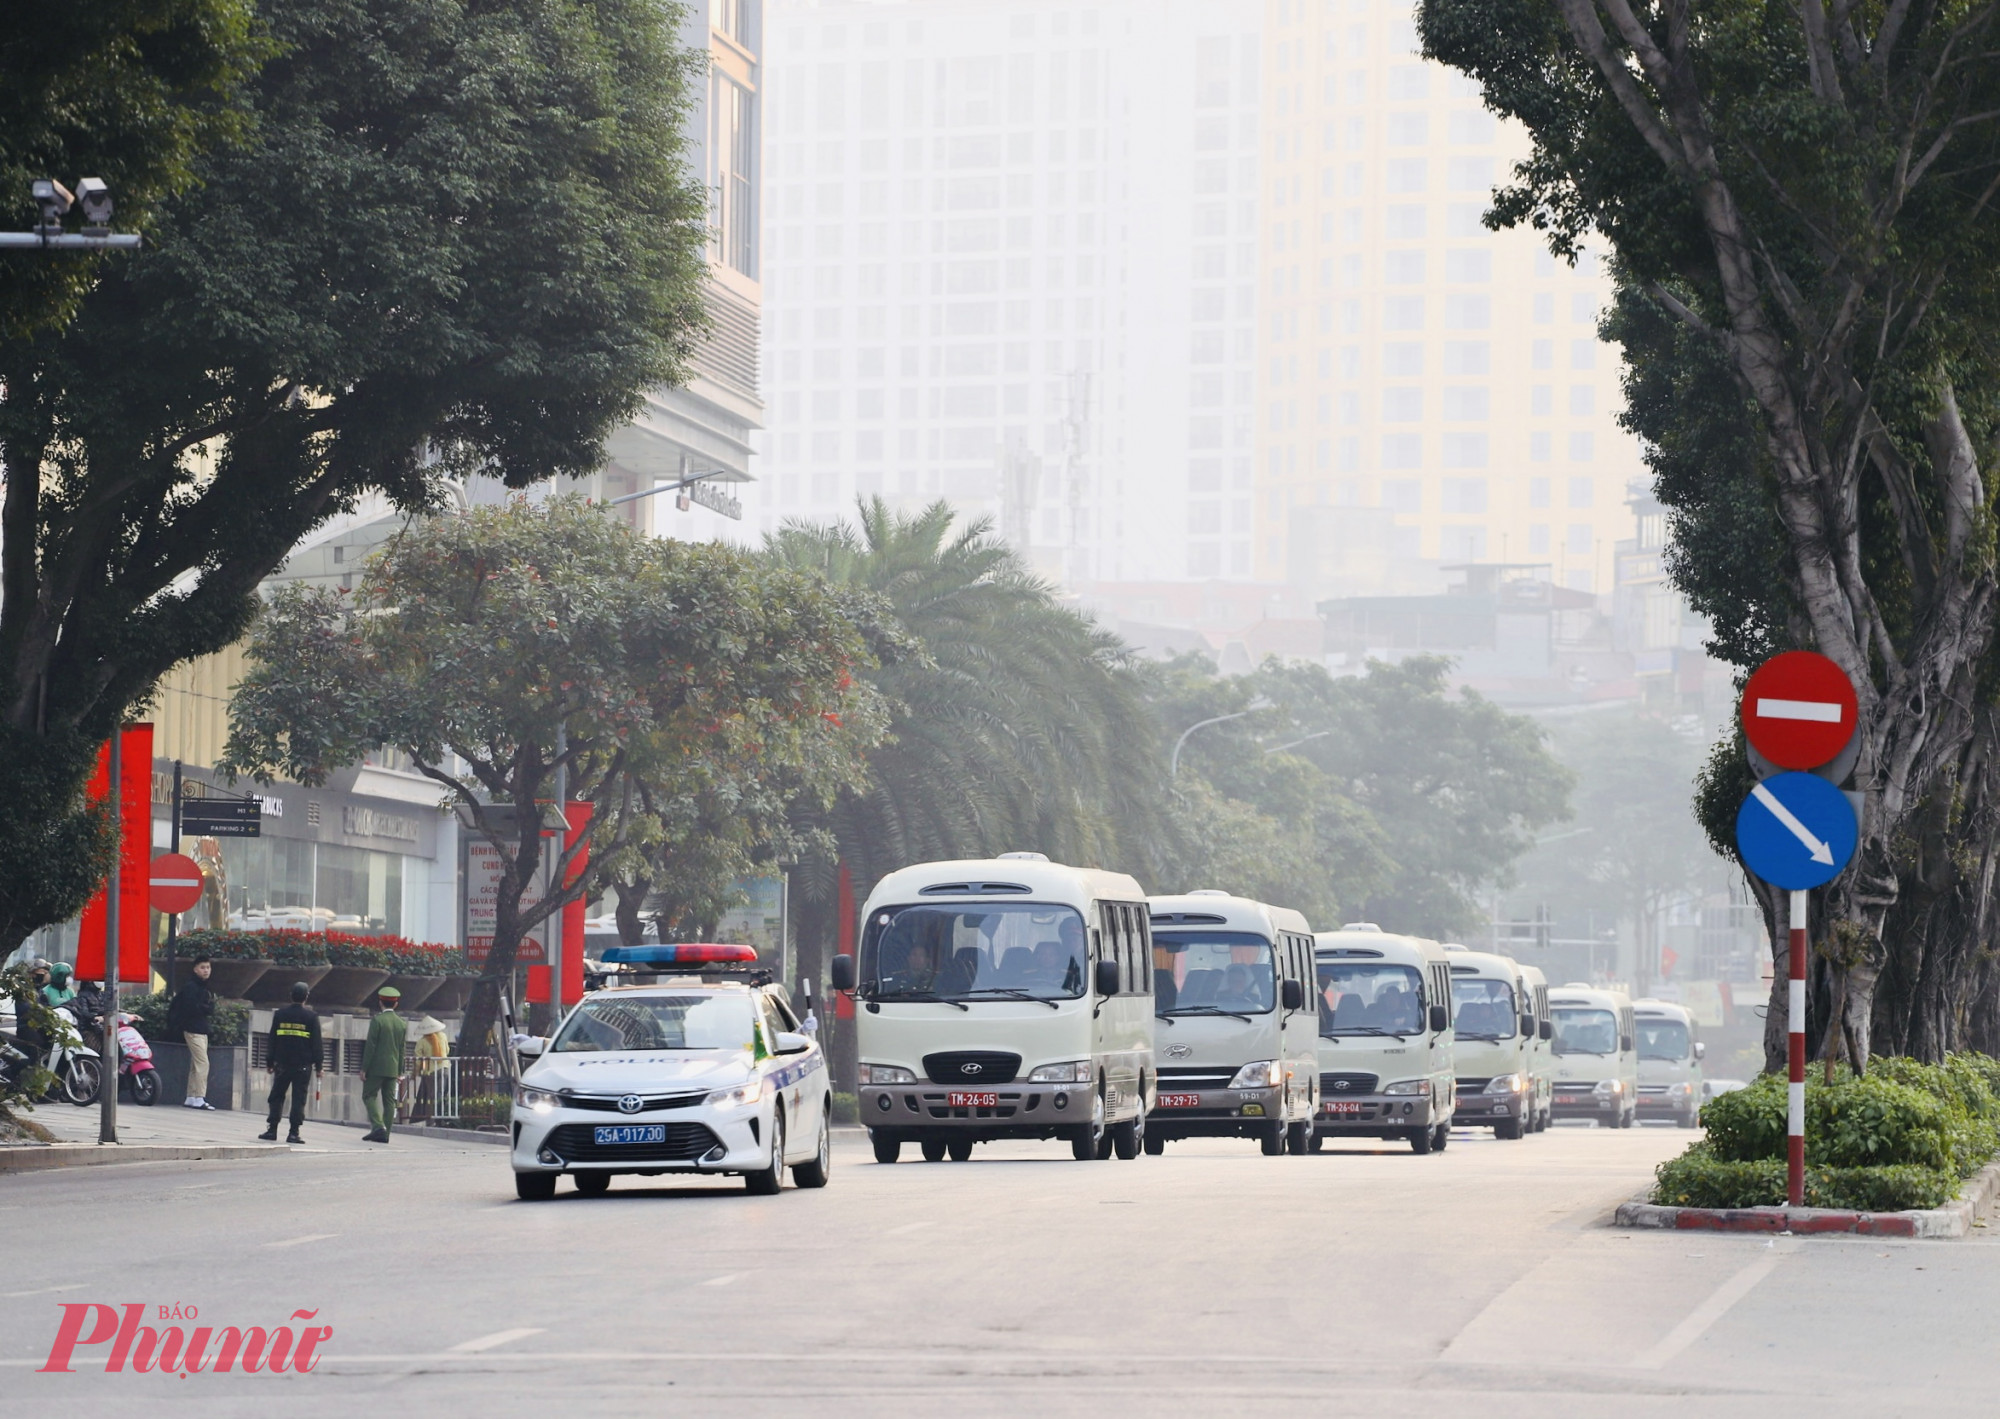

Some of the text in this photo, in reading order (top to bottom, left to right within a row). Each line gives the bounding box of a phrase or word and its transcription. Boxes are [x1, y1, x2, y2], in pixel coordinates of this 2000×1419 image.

[470, 909, 494, 918] TRUNG
[951, 1093, 995, 1105] TM-26-05
[1160, 1095, 1198, 1106] TM-29-75
